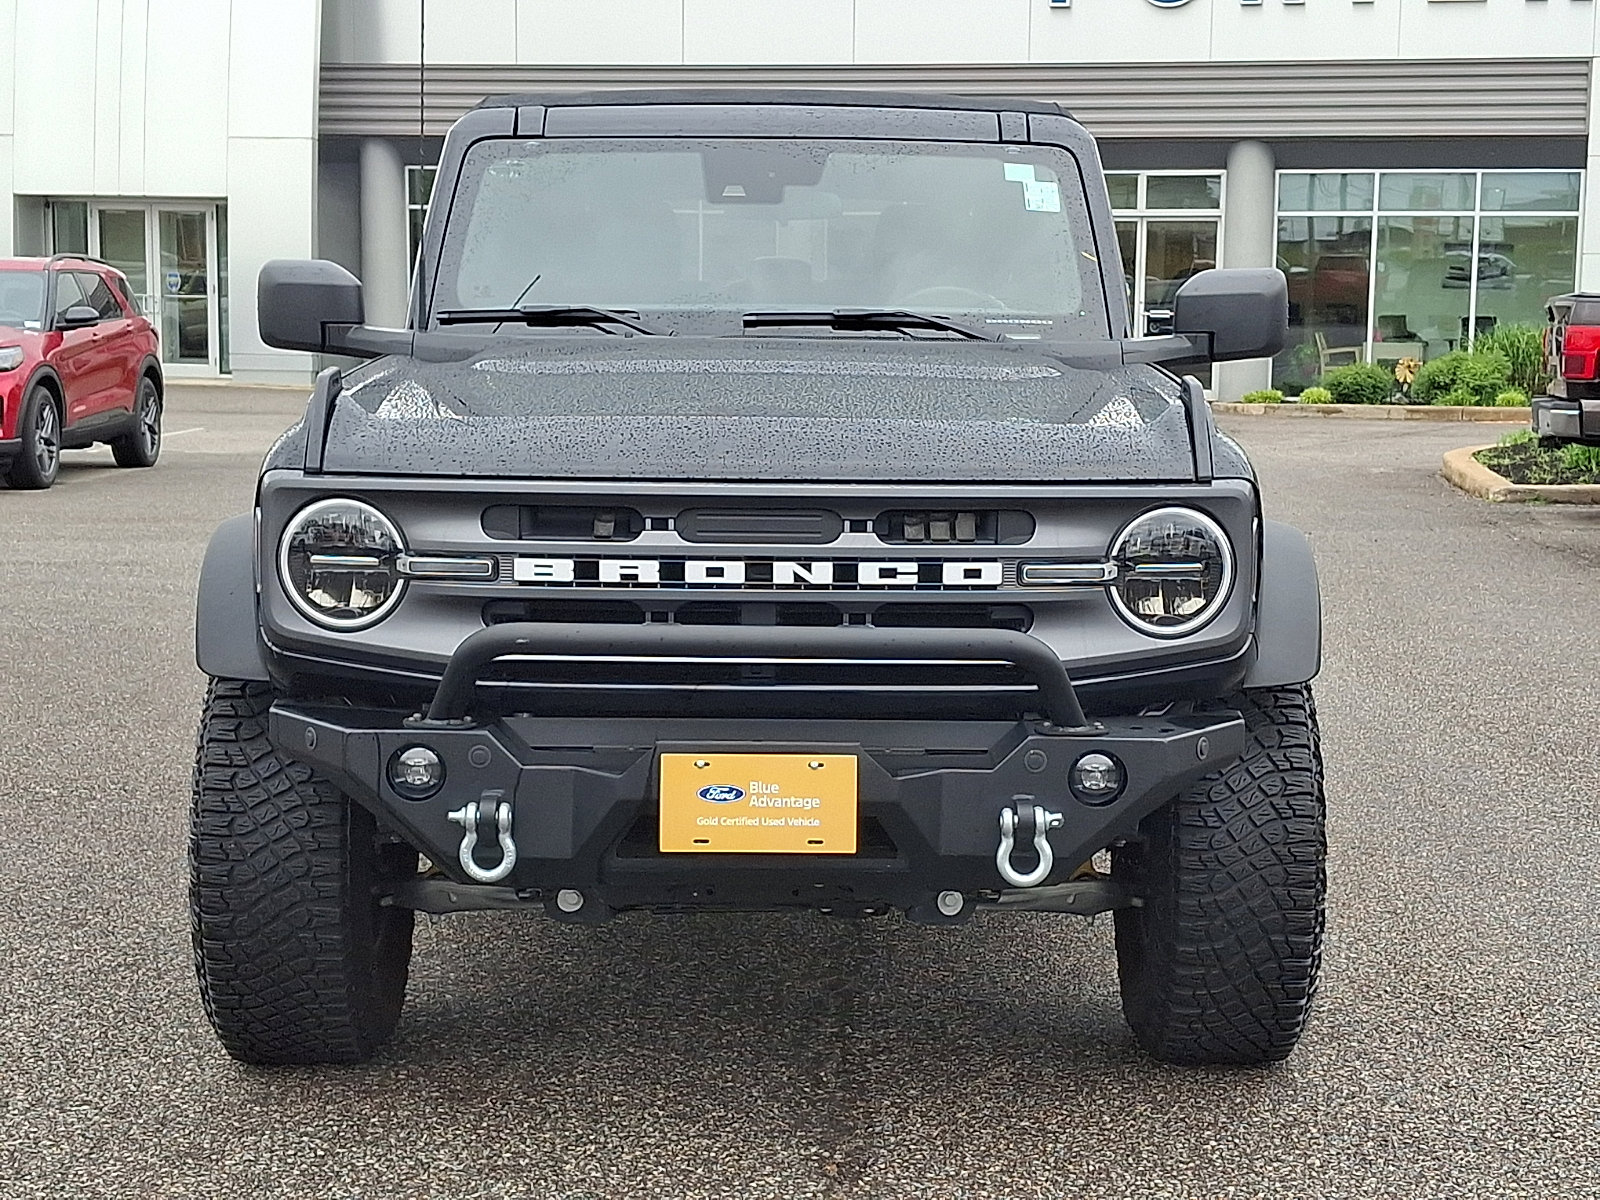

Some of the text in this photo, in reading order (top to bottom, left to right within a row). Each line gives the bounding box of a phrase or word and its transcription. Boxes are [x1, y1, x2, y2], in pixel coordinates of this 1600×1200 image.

[513, 557, 1002, 585] BRONCO
[706, 787, 736, 800] Ford
[749, 781, 779, 794] Blue
[749, 796, 820, 809] Advantage
[696, 816, 820, 826] Gold Certified Used Vehicle
